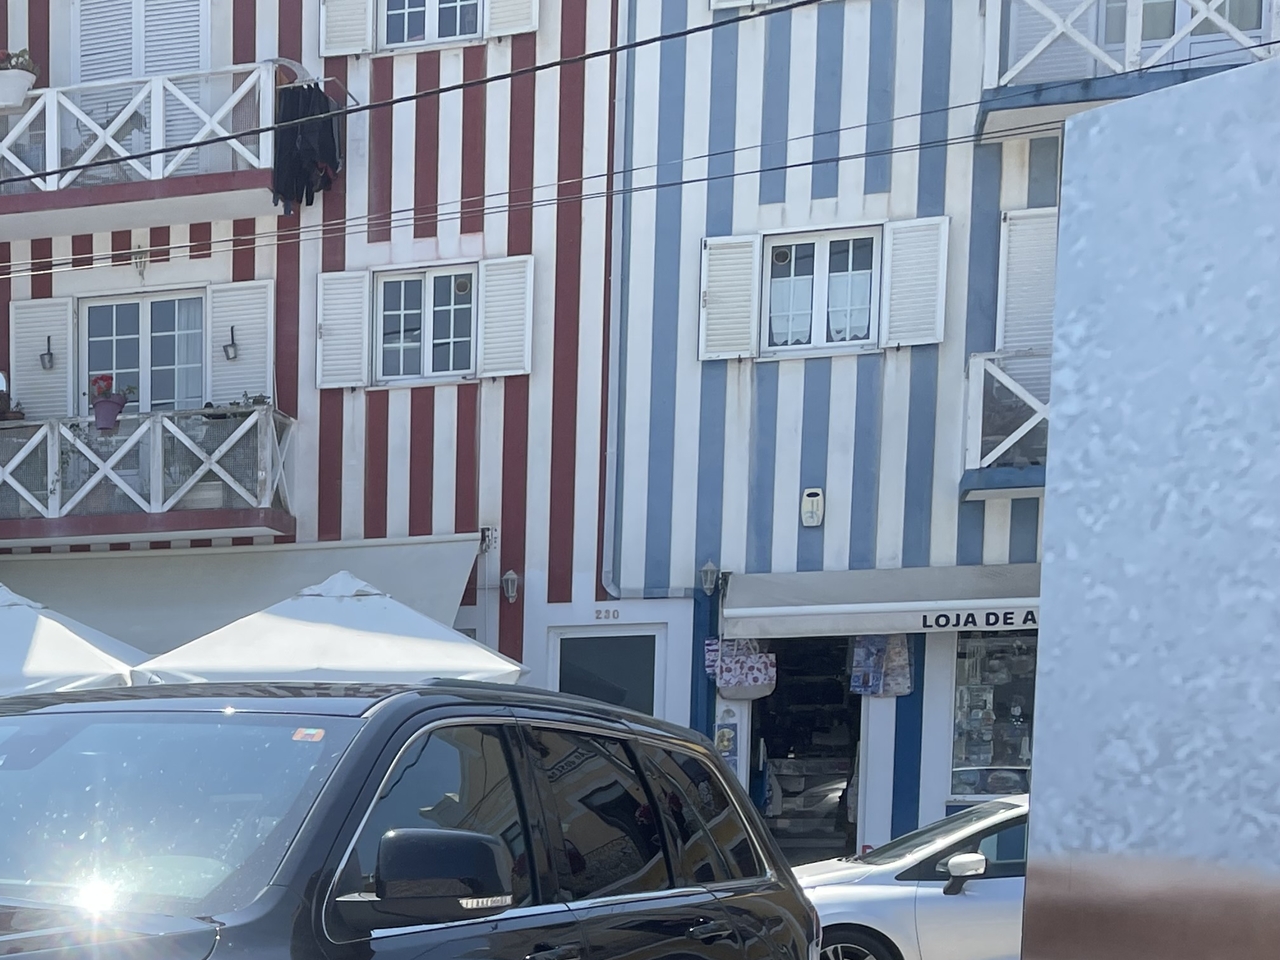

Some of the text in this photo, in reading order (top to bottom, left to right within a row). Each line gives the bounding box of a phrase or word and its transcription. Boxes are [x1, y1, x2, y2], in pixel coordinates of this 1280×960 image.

[595, 609, 619, 619] 230
[922, 612, 977, 628] LOJA
[985, 611, 1015, 626] DE
